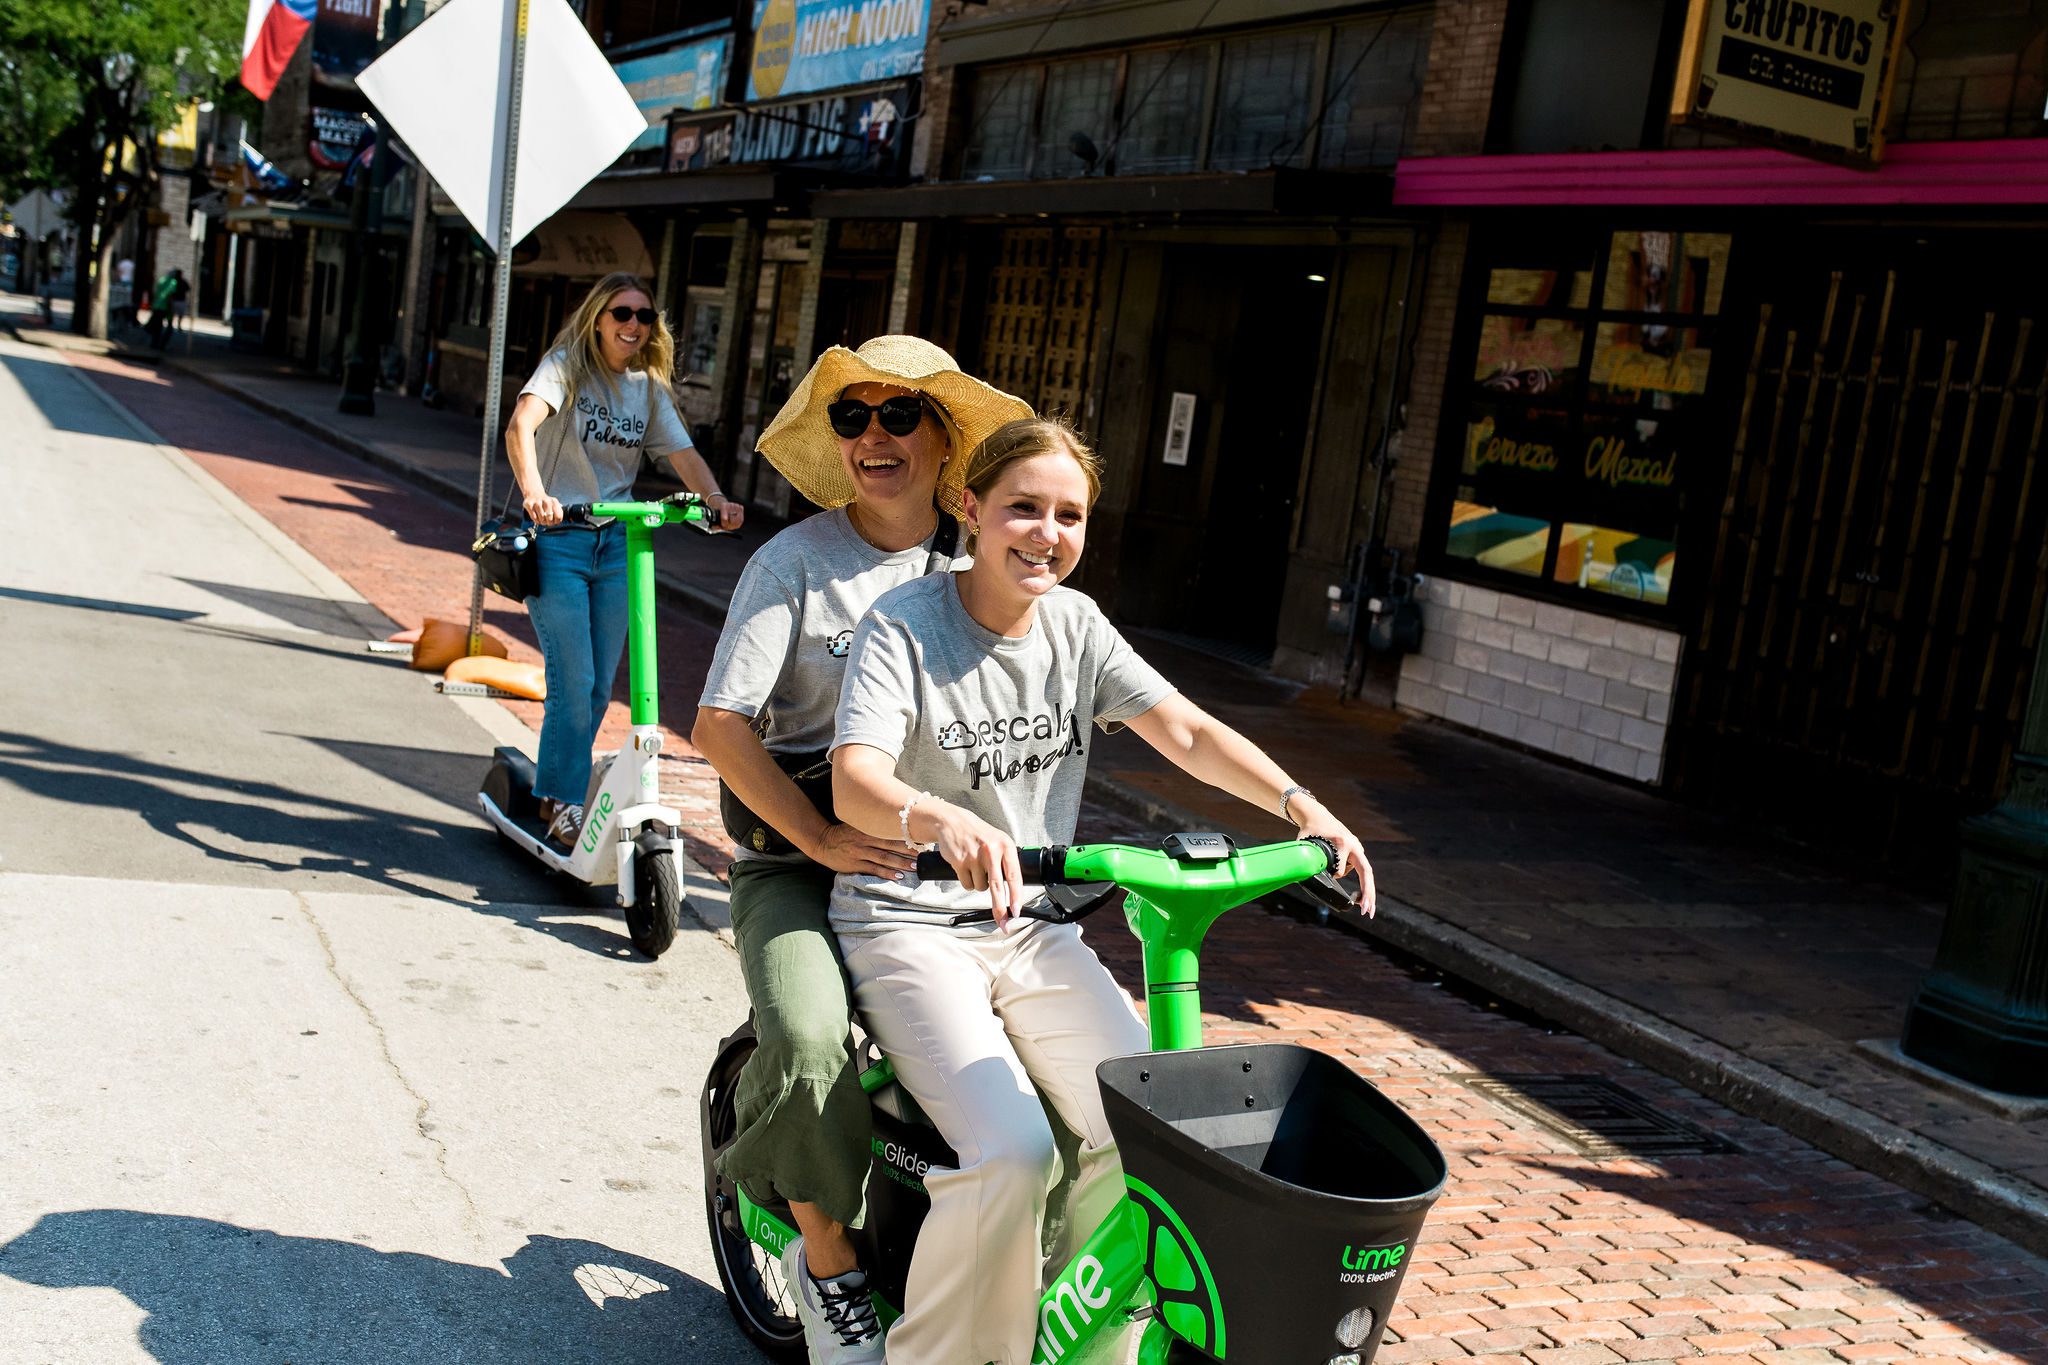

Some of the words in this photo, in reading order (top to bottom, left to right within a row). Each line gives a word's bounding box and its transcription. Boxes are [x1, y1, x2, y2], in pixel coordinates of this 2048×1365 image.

[800, 4, 853, 57] HIGH
[856, 0, 924, 48] NOON
[1725, 0, 1874, 66] CHUPITOS
[704, 122, 732, 169] THE
[730, 105, 799, 164] BLIND
[801, 96, 846, 158] PIG
[1472, 416, 1559, 472] Cerveza
[1584, 434, 1676, 488] Mezcal
[581, 792, 614, 853] Lime
[1186, 837, 1219, 847] Lime
[761, 1222, 777, 1246] On
[1342, 1244, 1405, 1270] Lime
[1340, 1272, 1365, 1284] 100%
[1366, 1268, 1397, 1284] Electric
[1031, 1254, 1112, 1365] ime
